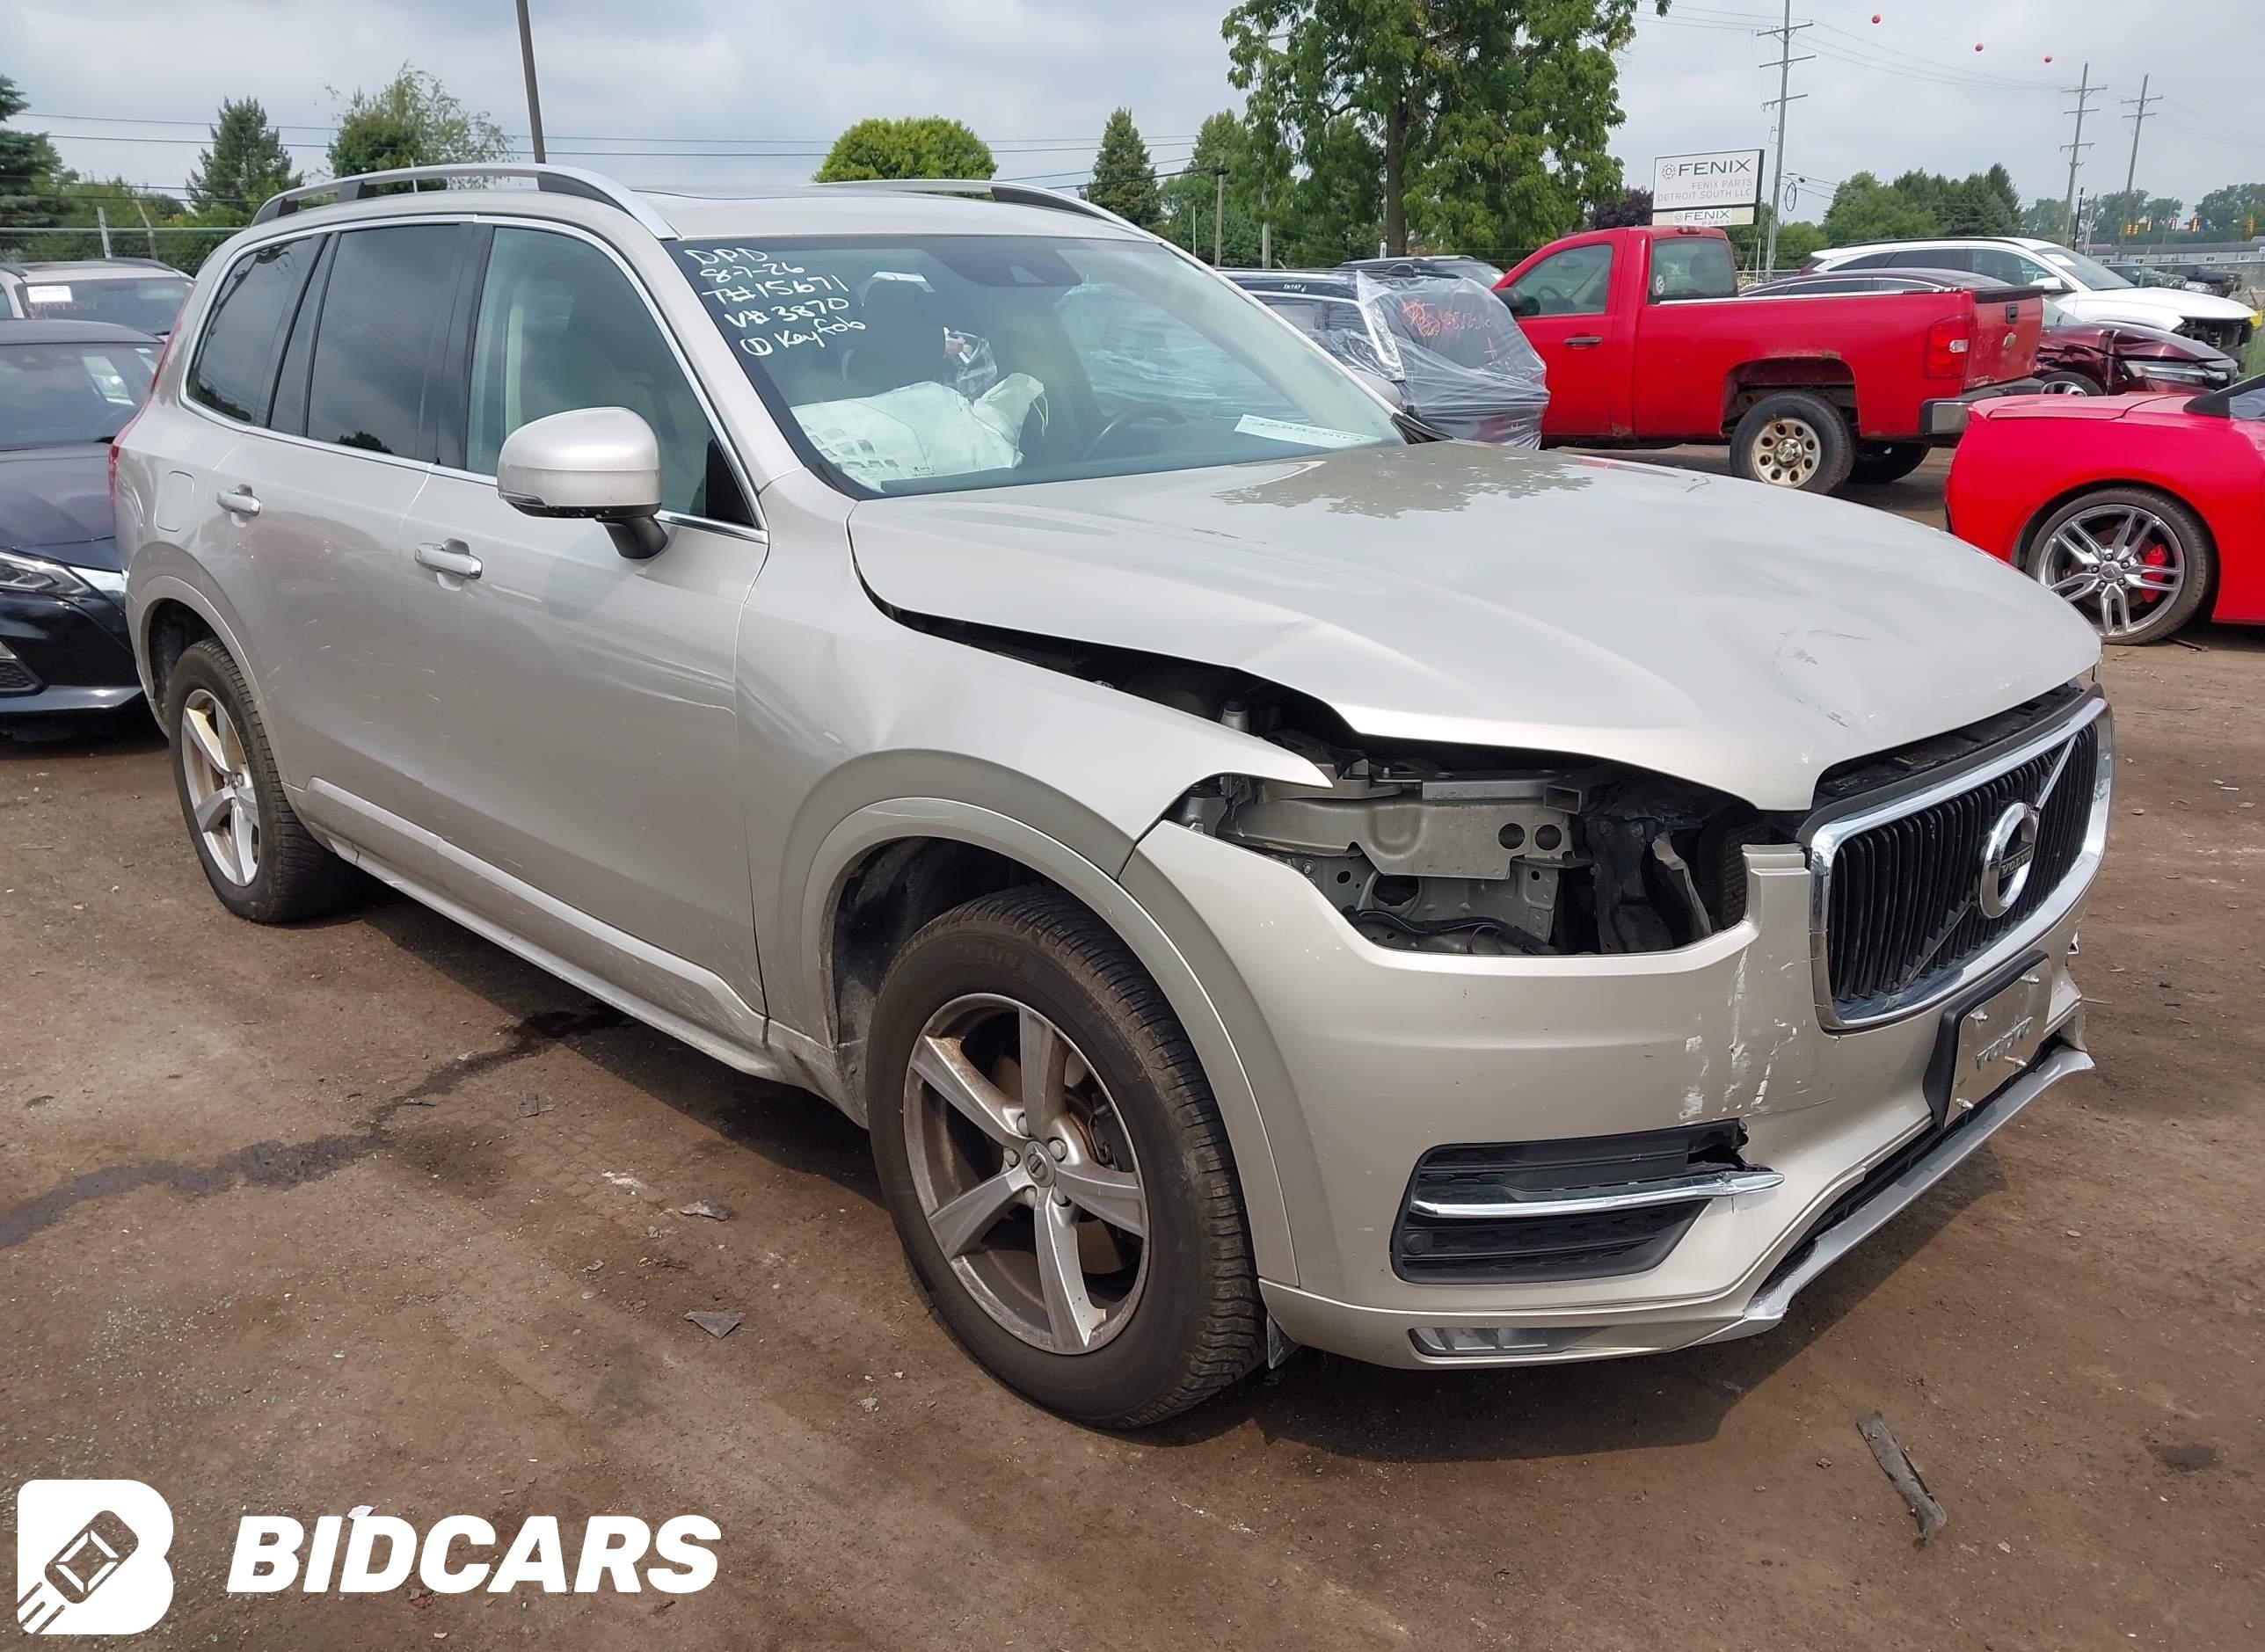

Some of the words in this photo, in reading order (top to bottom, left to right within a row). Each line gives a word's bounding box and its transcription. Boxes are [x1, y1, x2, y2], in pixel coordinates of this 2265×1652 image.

[1679, 159, 1752, 176] FENIX
[1692, 181, 1719, 190] FENIX
[1722, 178, 1752, 187] PARTS
[1657, 191, 1697, 202] DETROIT
[1701, 189, 1732, 200] SOUTH
[1735, 188, 1752, 197] LLC
[1685, 210, 1730, 221] FENIX
[684, 247, 768, 266] DPD
[1999, 850, 2032, 874] VOLVO
